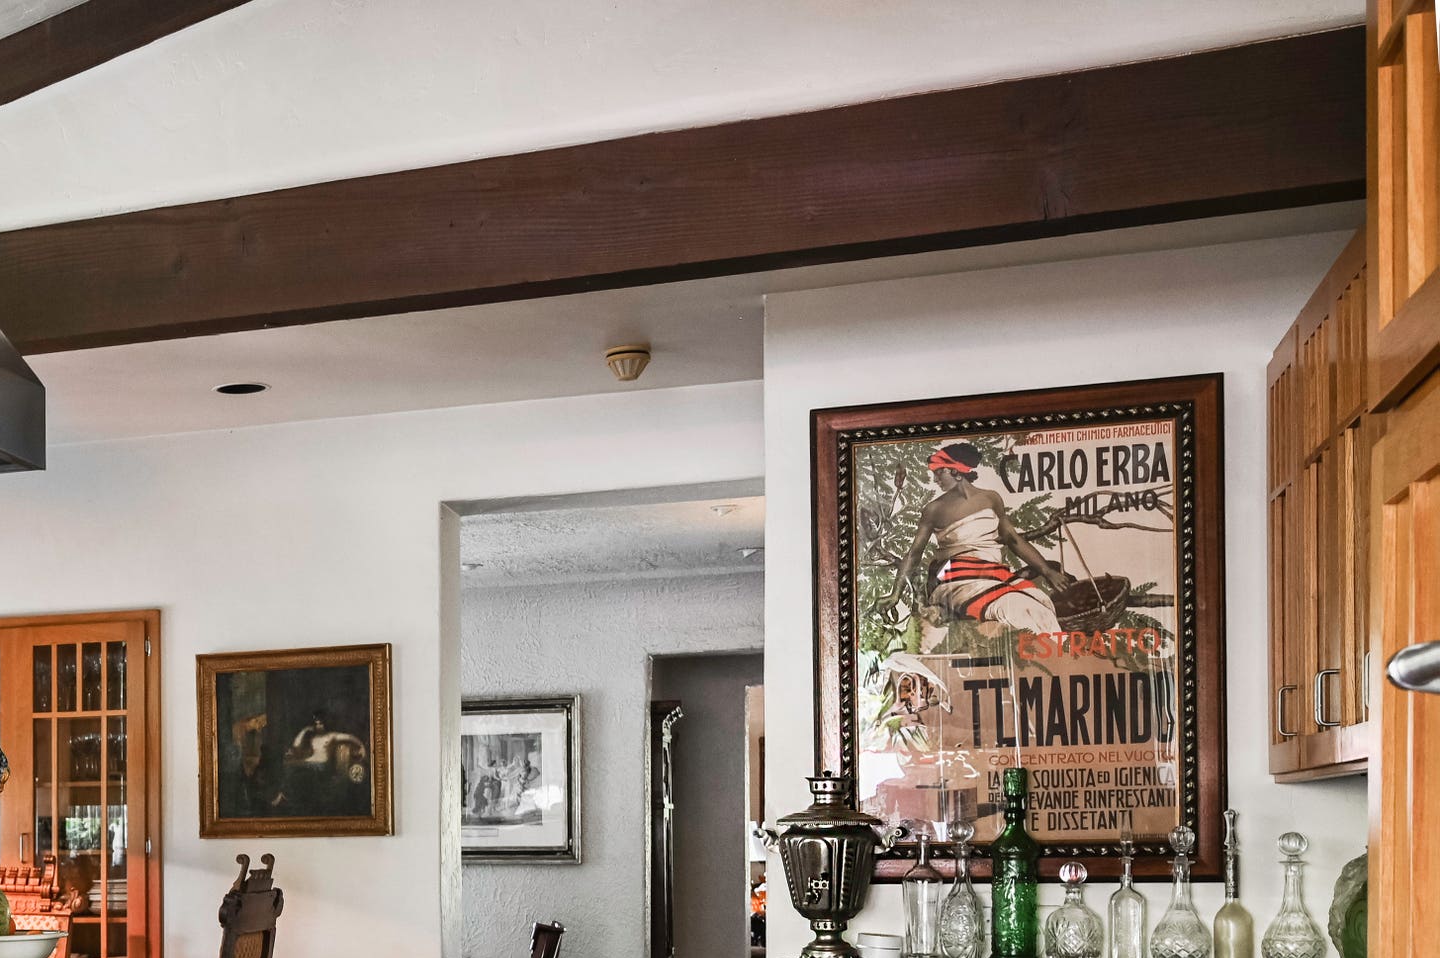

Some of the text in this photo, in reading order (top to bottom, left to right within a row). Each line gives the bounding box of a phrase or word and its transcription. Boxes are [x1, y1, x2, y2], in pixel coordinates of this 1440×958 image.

[1076, 428, 1111, 442] CHIMICO
[1000, 442, 1171, 493] CARLO ERBA
[1065, 489, 1158, 517] MILANO
[1018, 627, 1161, 659] ESTRATTO
[1098, 751, 1123, 763] NEL
[988, 766, 1175, 790] LA SQUISITA ED IGIENICA
[1024, 790, 1080, 810] EVANDE
[1084, 787, 1176, 808] RINFRESCANTI
[1031, 809, 1133, 831] E DISSETANTI
